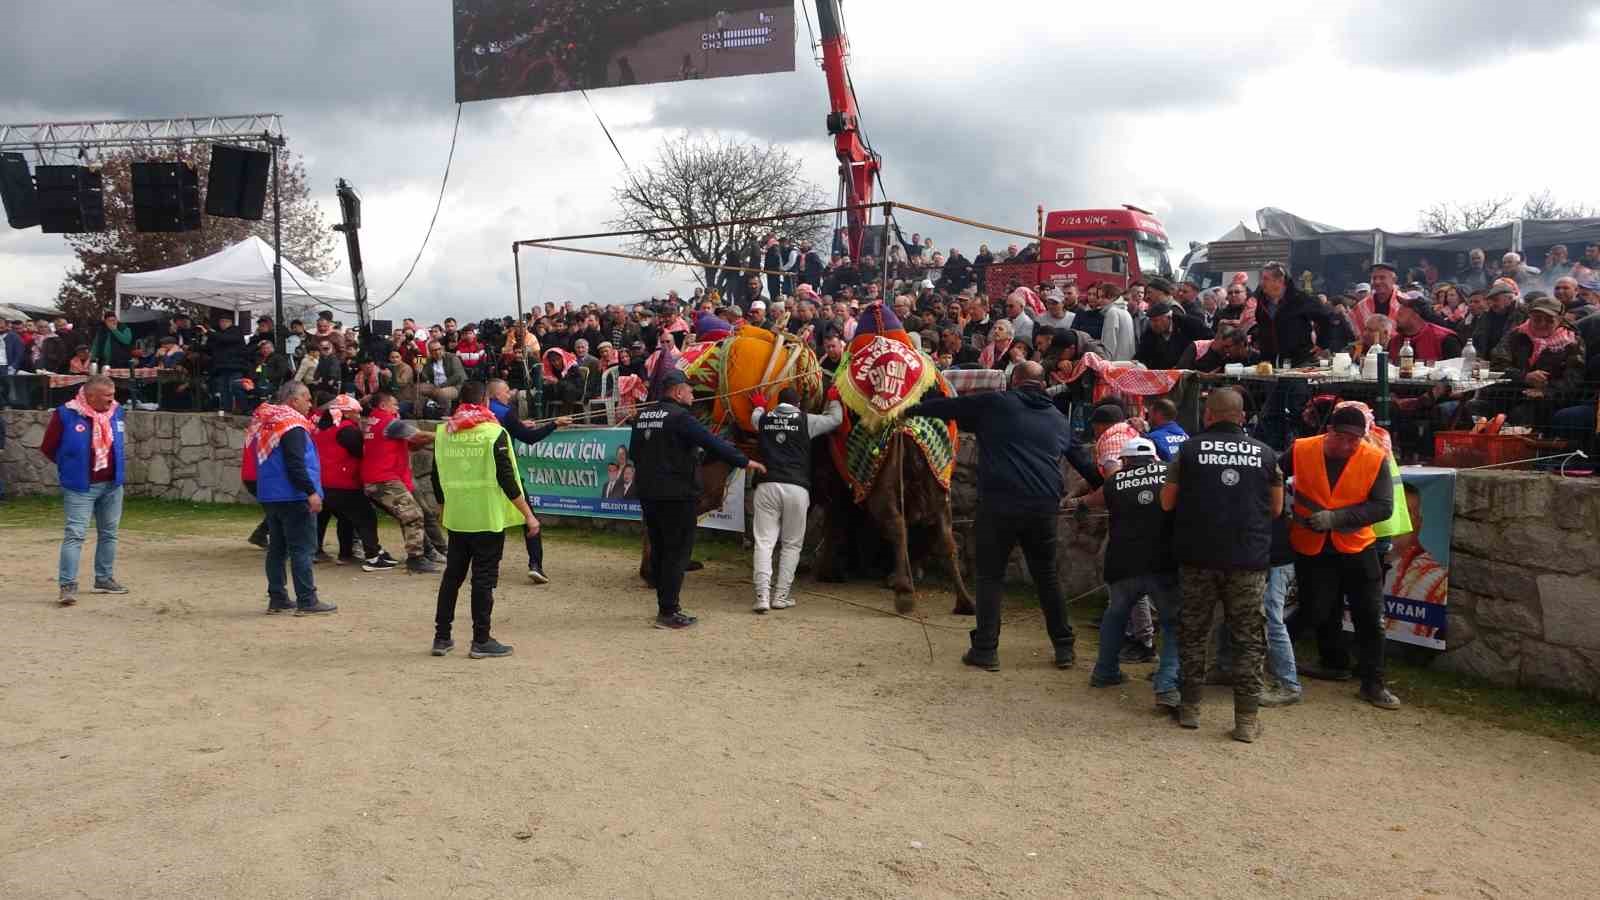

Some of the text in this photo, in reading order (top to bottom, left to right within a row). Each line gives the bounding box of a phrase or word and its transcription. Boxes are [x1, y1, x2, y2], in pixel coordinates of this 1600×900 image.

[702, 31, 721, 41] CH1
[702, 41, 722, 50] CH2
[517, 438, 606, 463] AYVACIK İÇİN
[1200, 439, 1262, 454] DEGÜF
[1198, 453, 1262, 468] URGANCI
[527, 465, 599, 488] TAM VAKTİ
[1115, 462, 1169, 480] DEGÜF
[1116, 475, 1167, 491] URGANC
[529, 495, 541, 506] ER
[1385, 600, 1426, 619] YRAM
